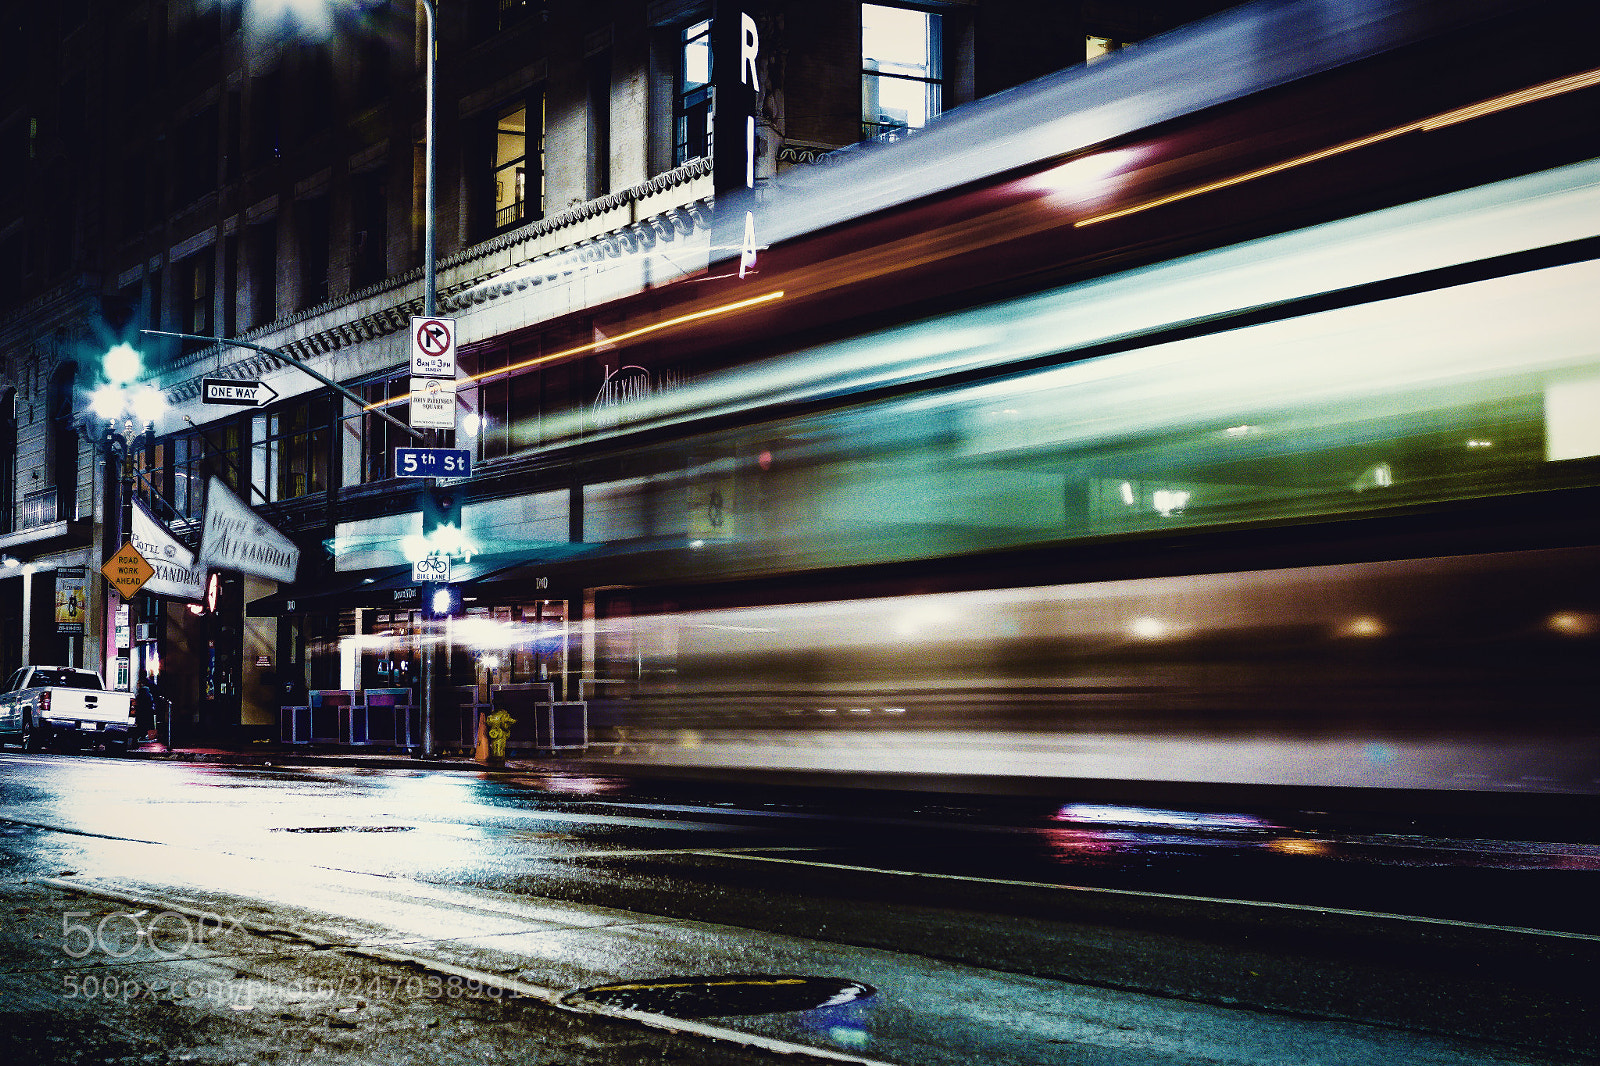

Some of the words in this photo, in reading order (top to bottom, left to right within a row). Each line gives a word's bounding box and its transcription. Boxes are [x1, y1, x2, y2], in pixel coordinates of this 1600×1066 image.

[211, 387, 232, 397] ONE
[236, 388, 257, 398] WAY
[403, 453, 436, 472] 5th
[444, 455, 465, 471] St
[117, 556, 139, 564] ROAD
[118, 566, 139, 575] WORK
[115, 577, 141, 585] AHEAD
[431, 573, 446, 581] LANE
